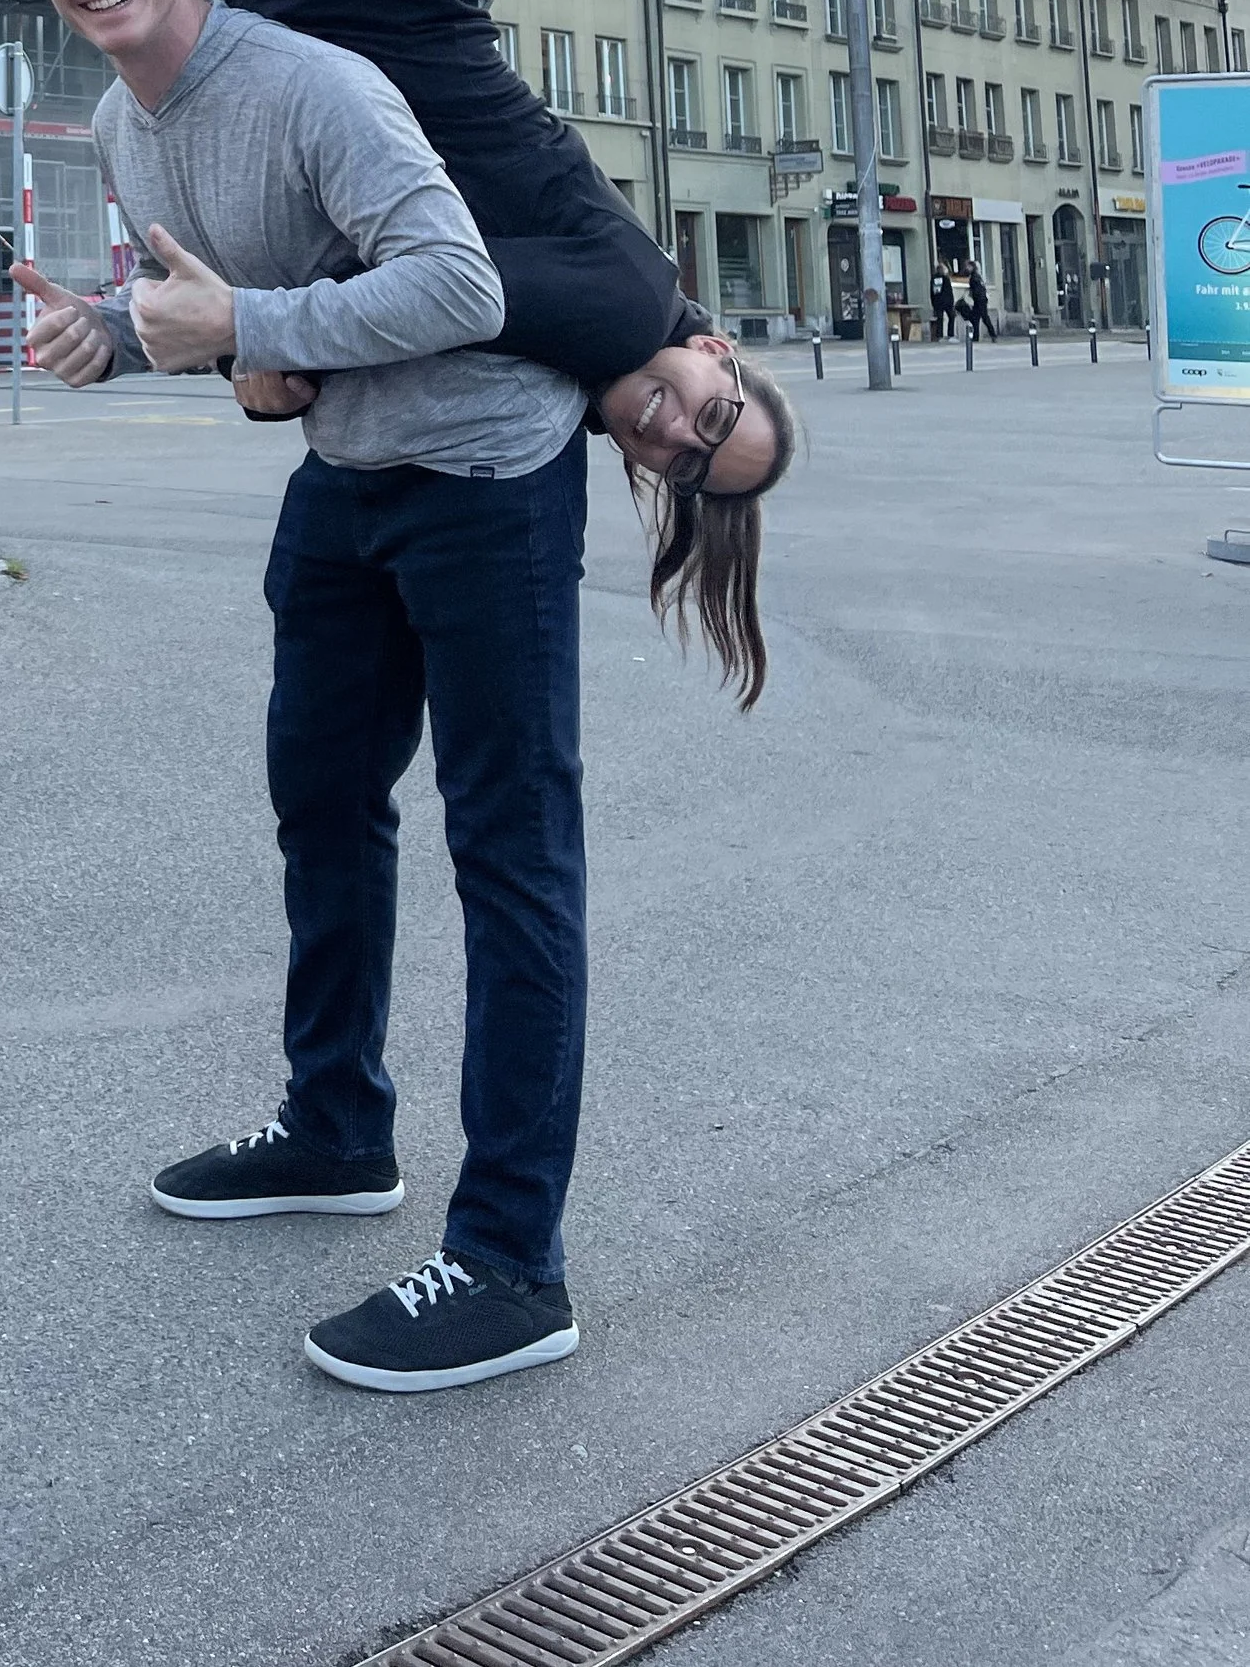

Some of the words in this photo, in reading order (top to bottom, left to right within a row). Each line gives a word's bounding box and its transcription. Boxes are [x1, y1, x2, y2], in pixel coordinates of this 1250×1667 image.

[1196, 283, 1219, 295] Fahr
[1222, 284, 1239, 295] mit
[1182, 368, 1207, 377] coop
